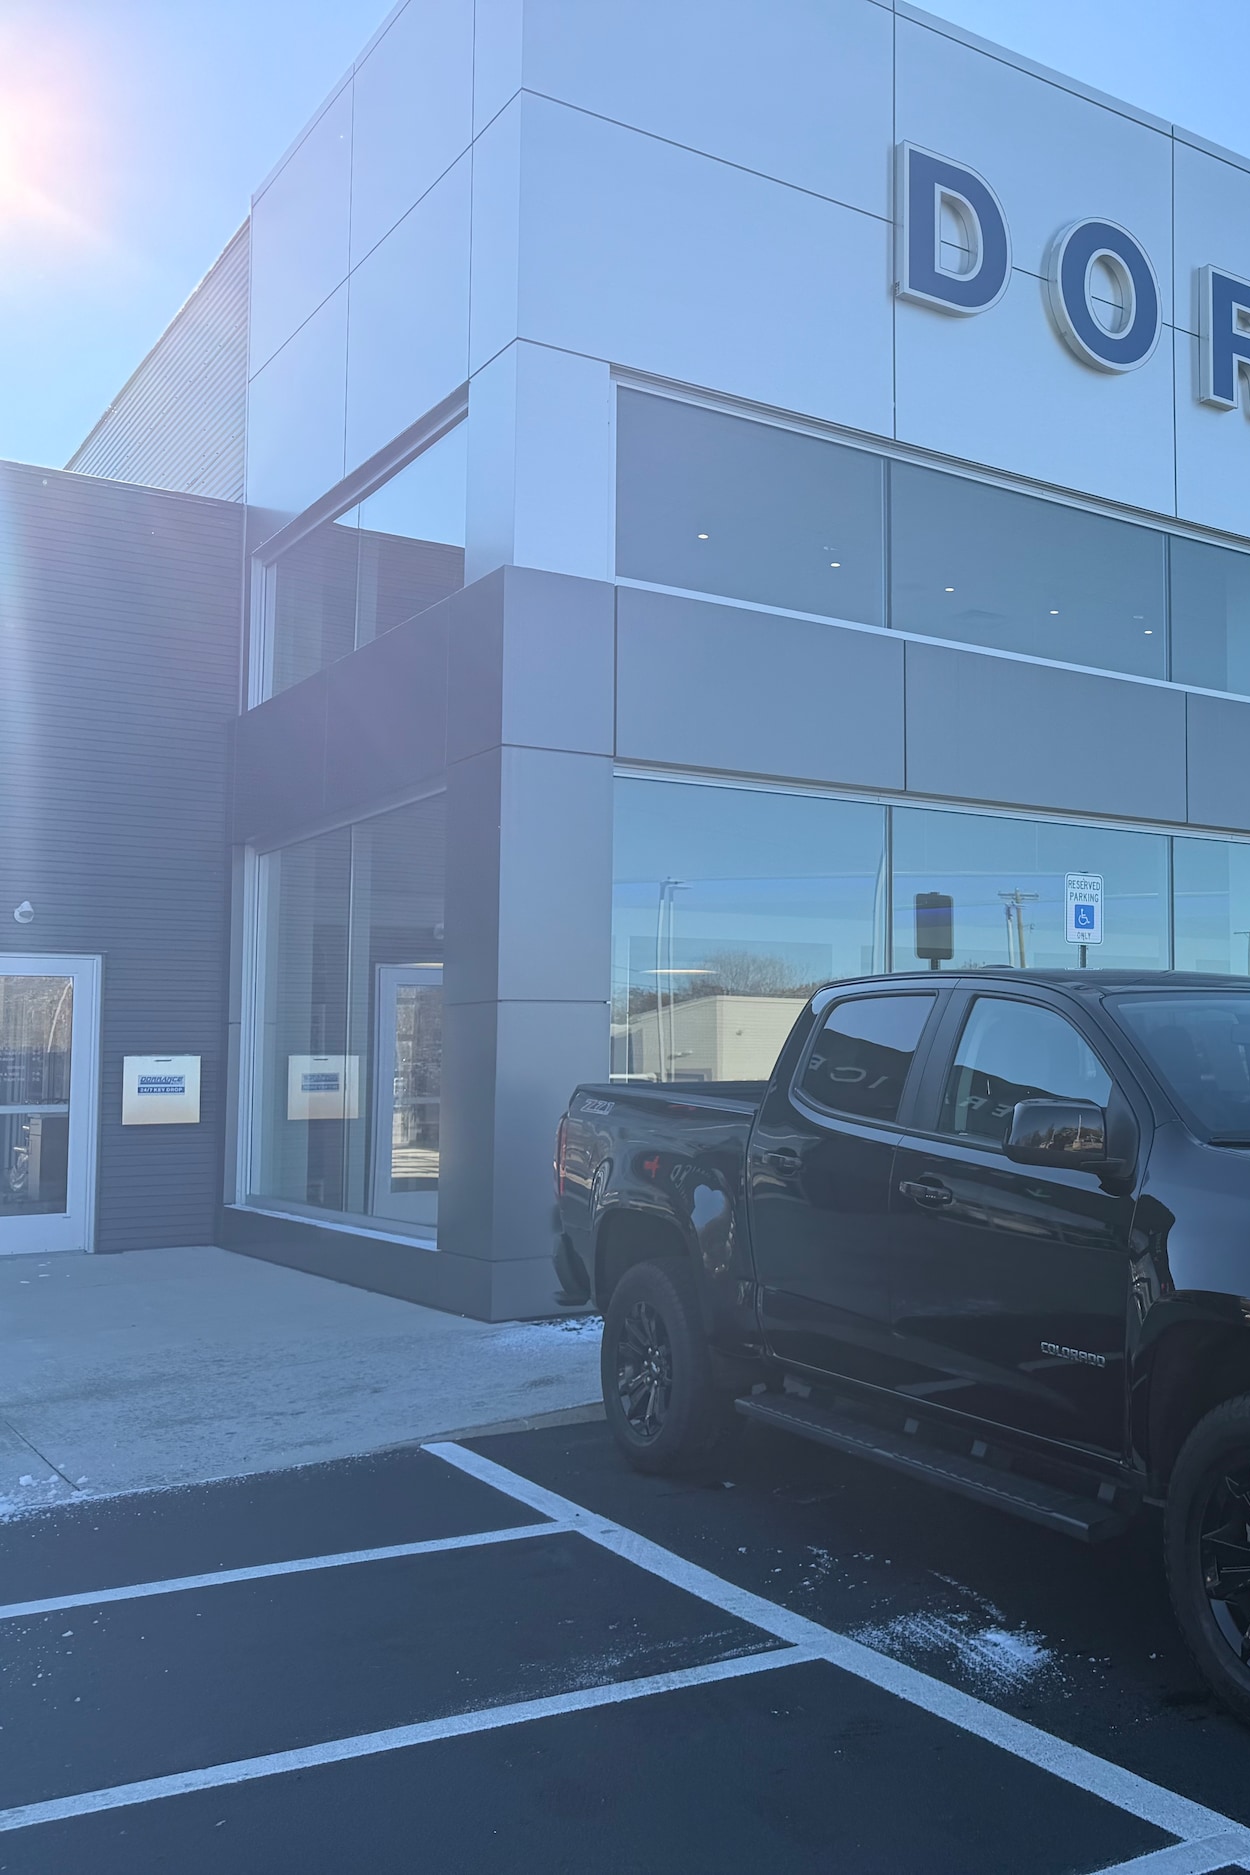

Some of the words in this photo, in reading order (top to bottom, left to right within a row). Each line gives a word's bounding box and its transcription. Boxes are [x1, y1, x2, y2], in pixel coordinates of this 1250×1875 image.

[1067, 879, 1101, 891] RESERVED
[1069, 892, 1099, 903] PARKING
[1076, 931, 1091, 940] ONLY
[140, 1076, 184, 1084] DORRANCE
[1040, 1341, 1105, 1369] COLORADO
